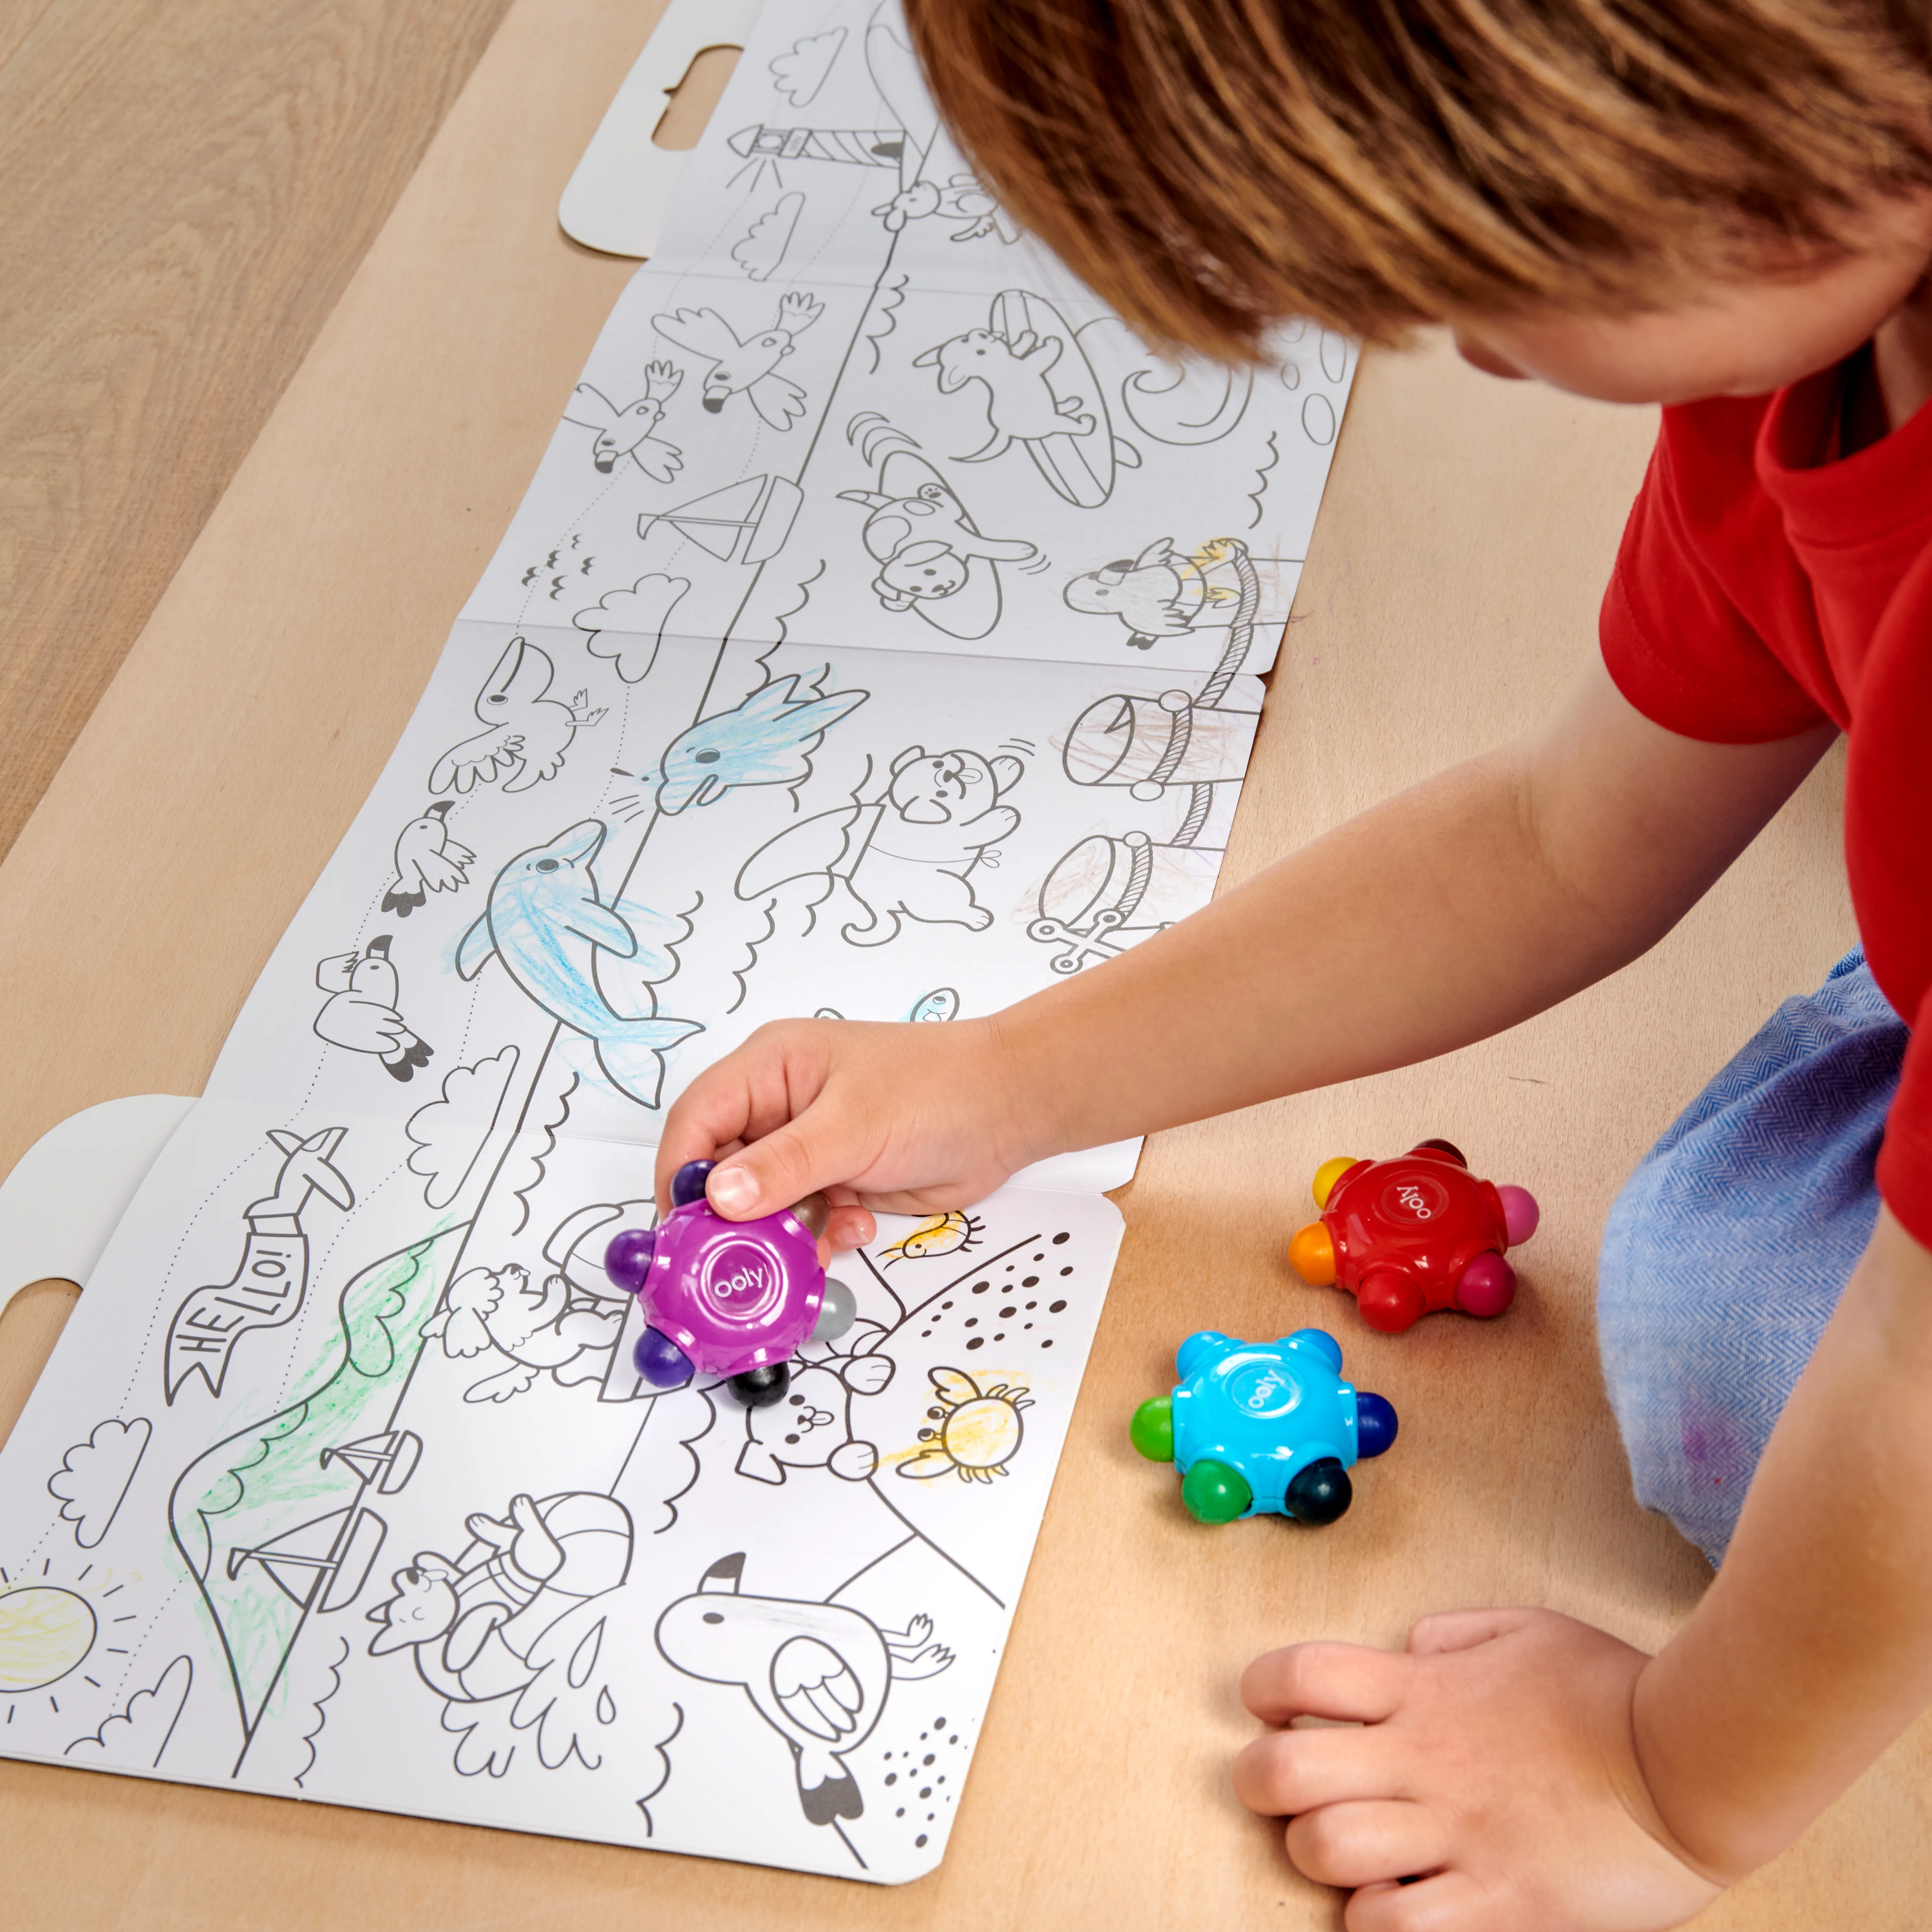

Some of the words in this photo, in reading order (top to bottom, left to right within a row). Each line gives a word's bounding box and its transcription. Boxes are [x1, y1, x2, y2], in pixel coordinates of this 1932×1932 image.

[1396, 1186, 1431, 1218] ooly
[714, 1267, 762, 1298] ooly
[176, 1249, 292, 1353] HELLO!
[1247, 1369, 1285, 1408] ooly
